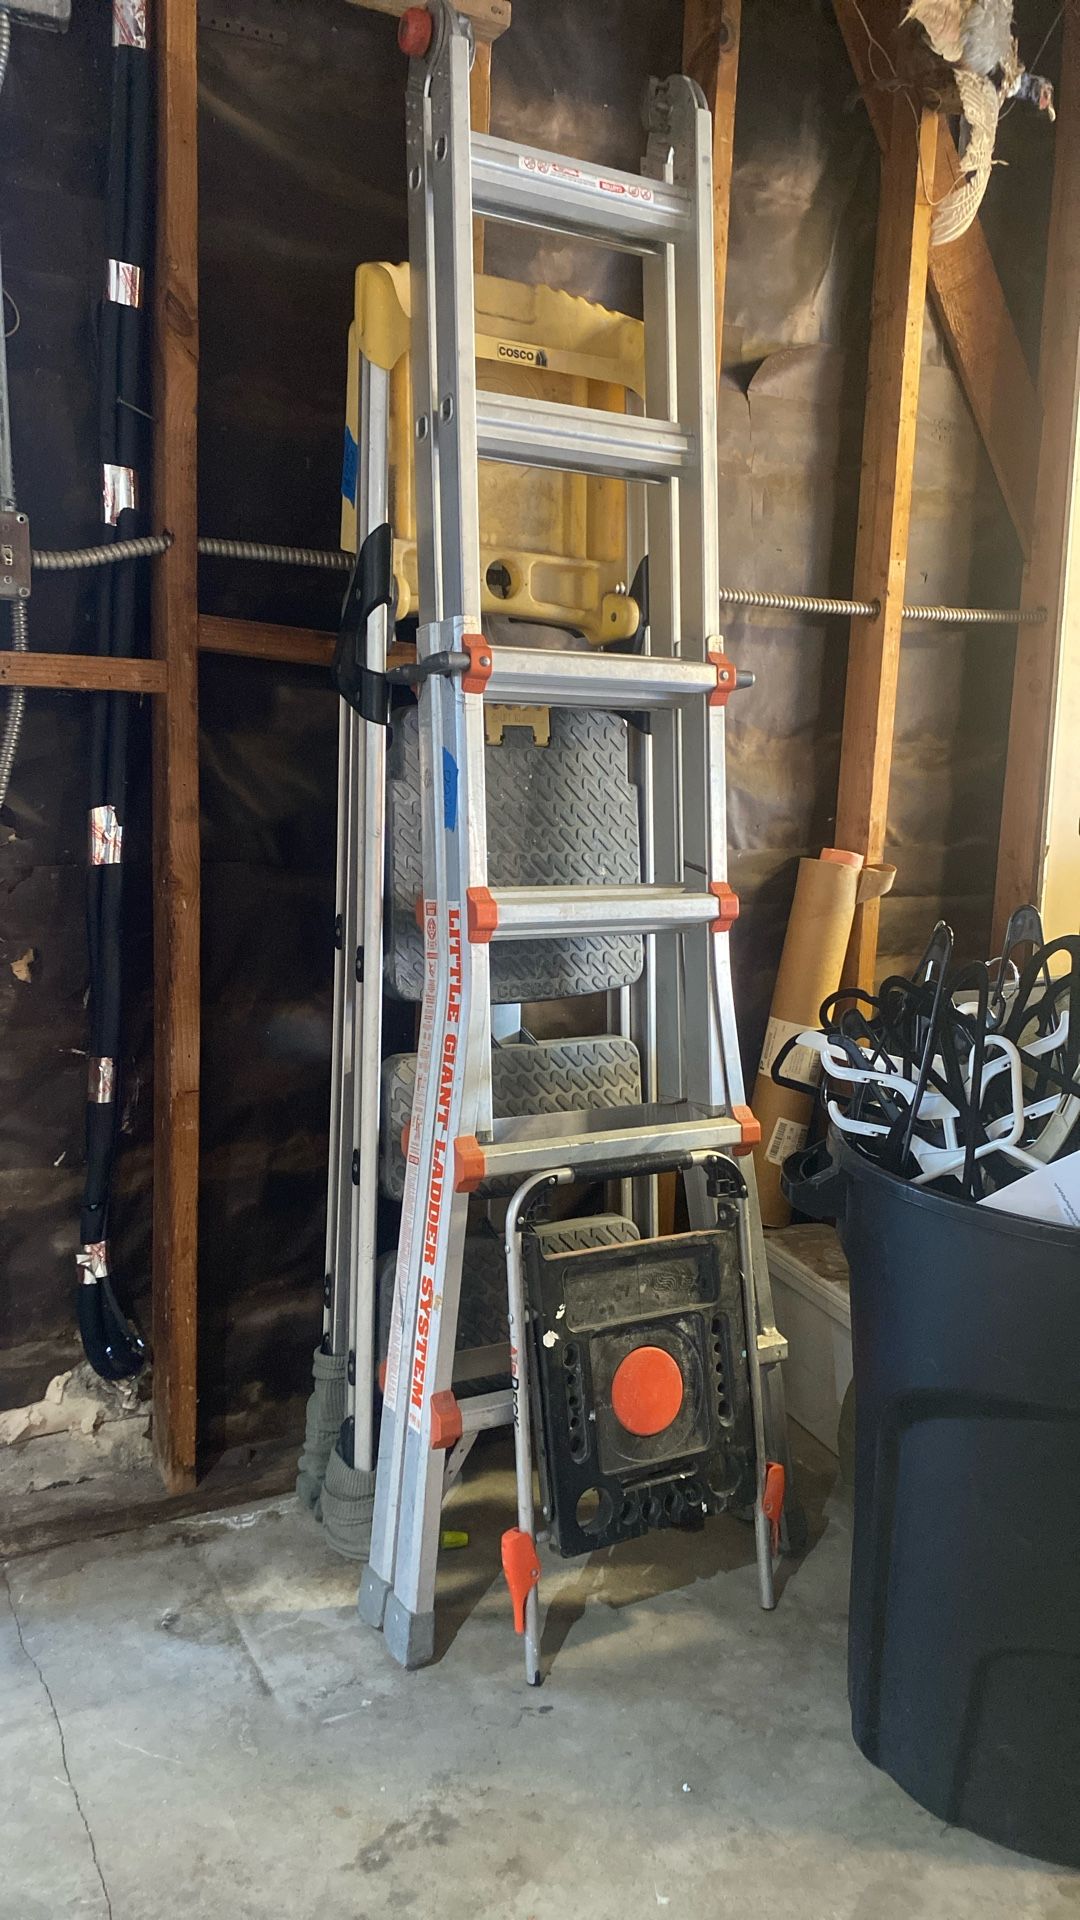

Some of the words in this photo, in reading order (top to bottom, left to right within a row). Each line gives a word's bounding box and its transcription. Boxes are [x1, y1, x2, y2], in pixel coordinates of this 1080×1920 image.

[499, 346, 534, 361] COSCO
[448, 909, 462, 1022] LITTLE
[437, 1034, 457, 1130] GIANT
[424, 1139, 446, 1265] LADDER
[411, 1277, 433, 1409] SYSTEM
